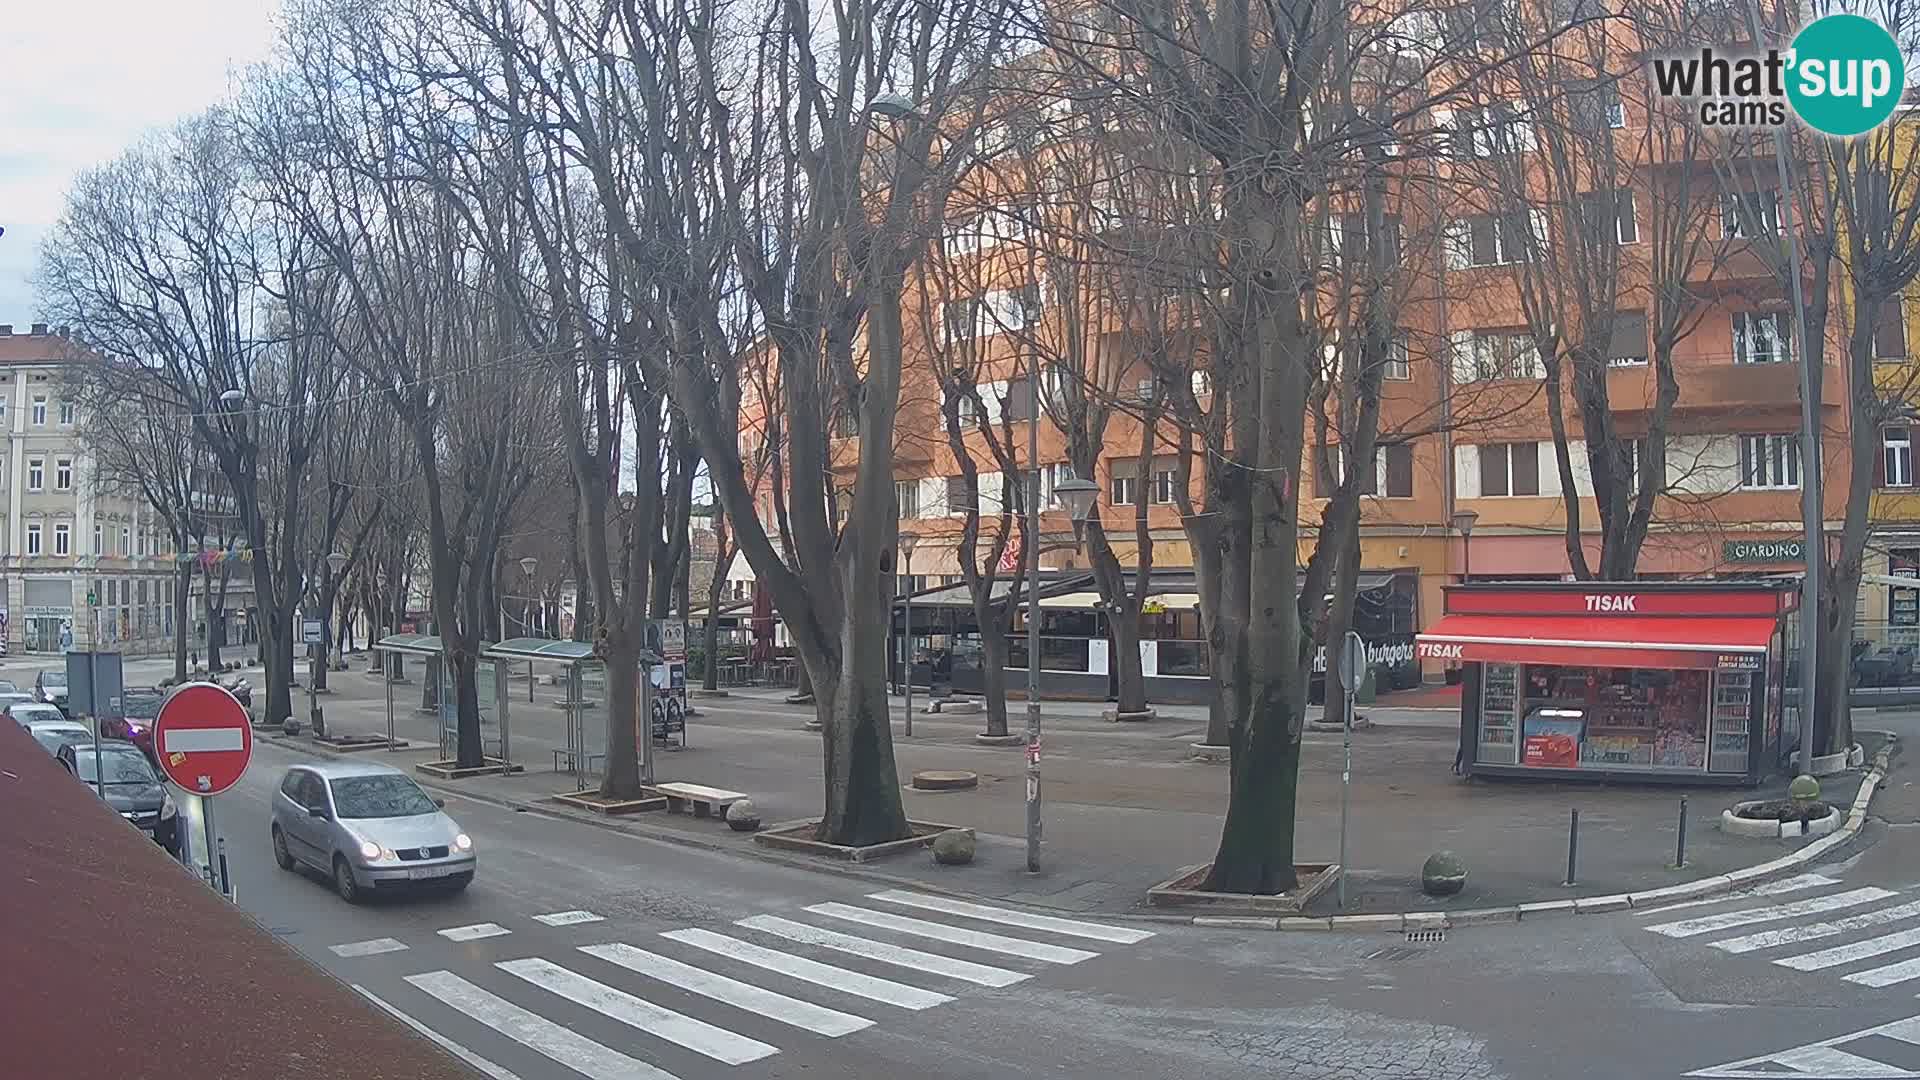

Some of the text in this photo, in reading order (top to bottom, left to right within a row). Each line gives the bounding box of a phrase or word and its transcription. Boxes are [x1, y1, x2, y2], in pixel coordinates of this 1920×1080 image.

[1735, 543, 1800, 558] GIARDINO
[1585, 595, 1637, 611] TISAK
[1367, 640, 1414, 668] burgers
[1418, 643, 1463, 659] TISAK
